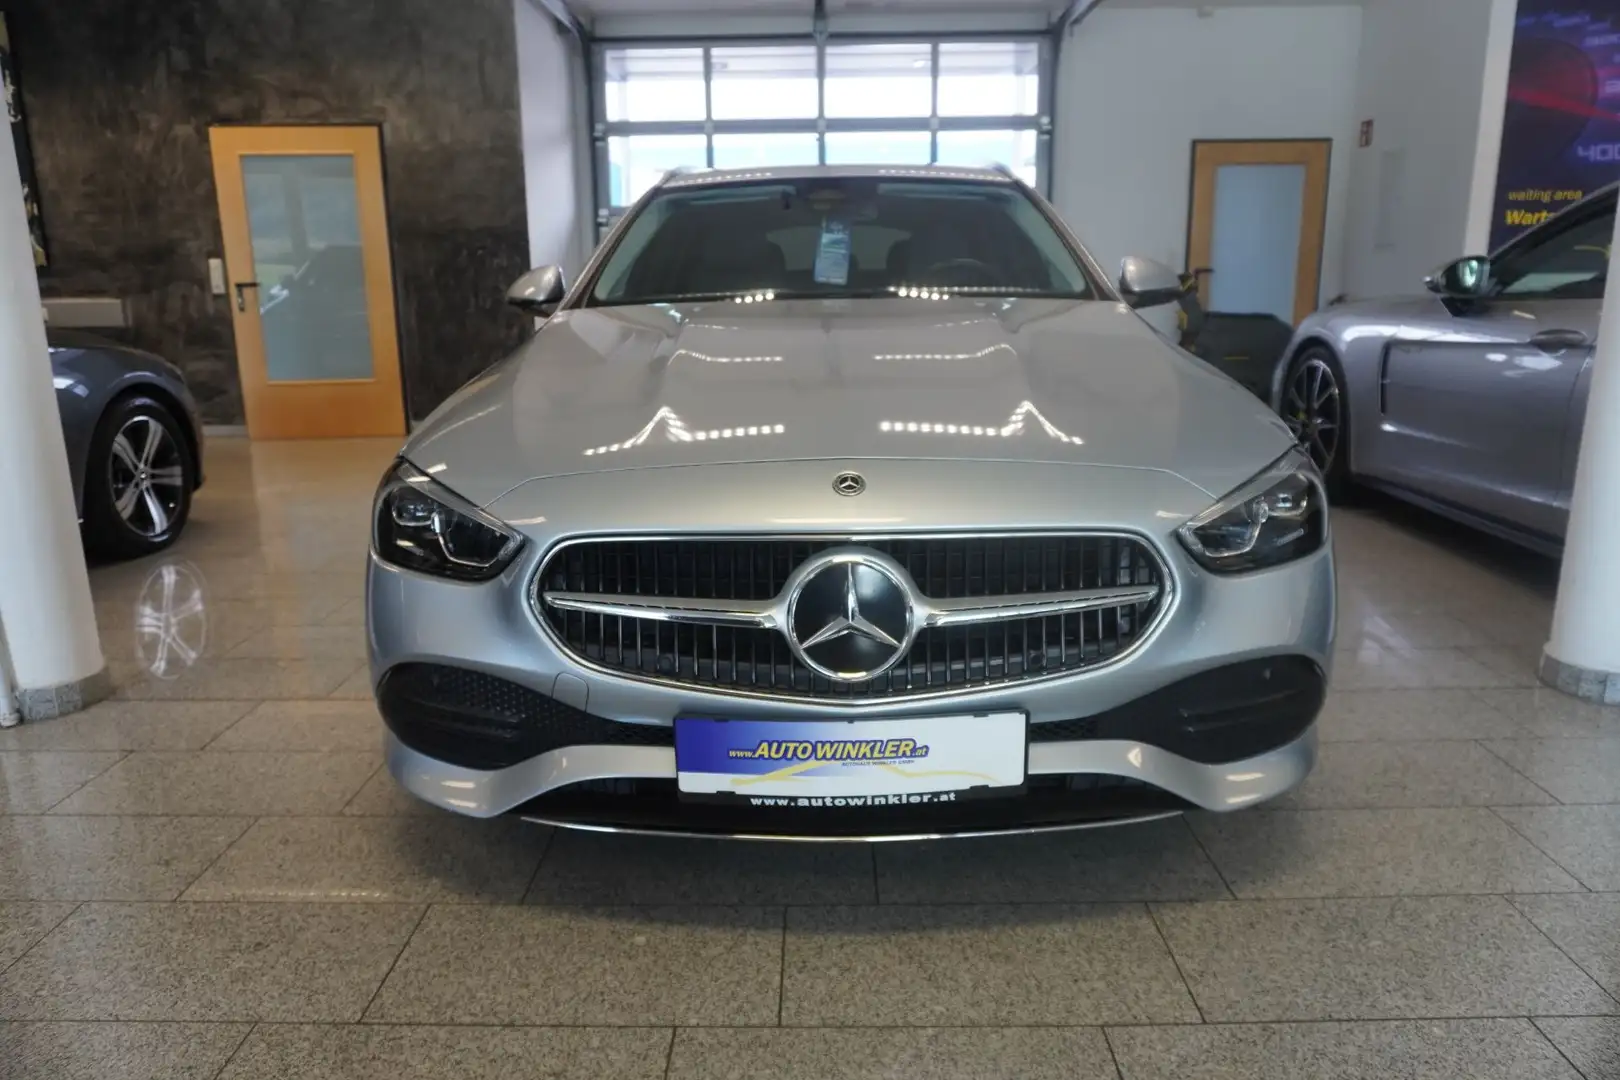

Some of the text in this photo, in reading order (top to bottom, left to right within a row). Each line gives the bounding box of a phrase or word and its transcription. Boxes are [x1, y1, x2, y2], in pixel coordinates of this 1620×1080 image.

[1508, 188, 1583, 203] waiting area
[1505, 208, 1557, 225] Wart
[750, 792, 956, 807] www.autowinkler.at
